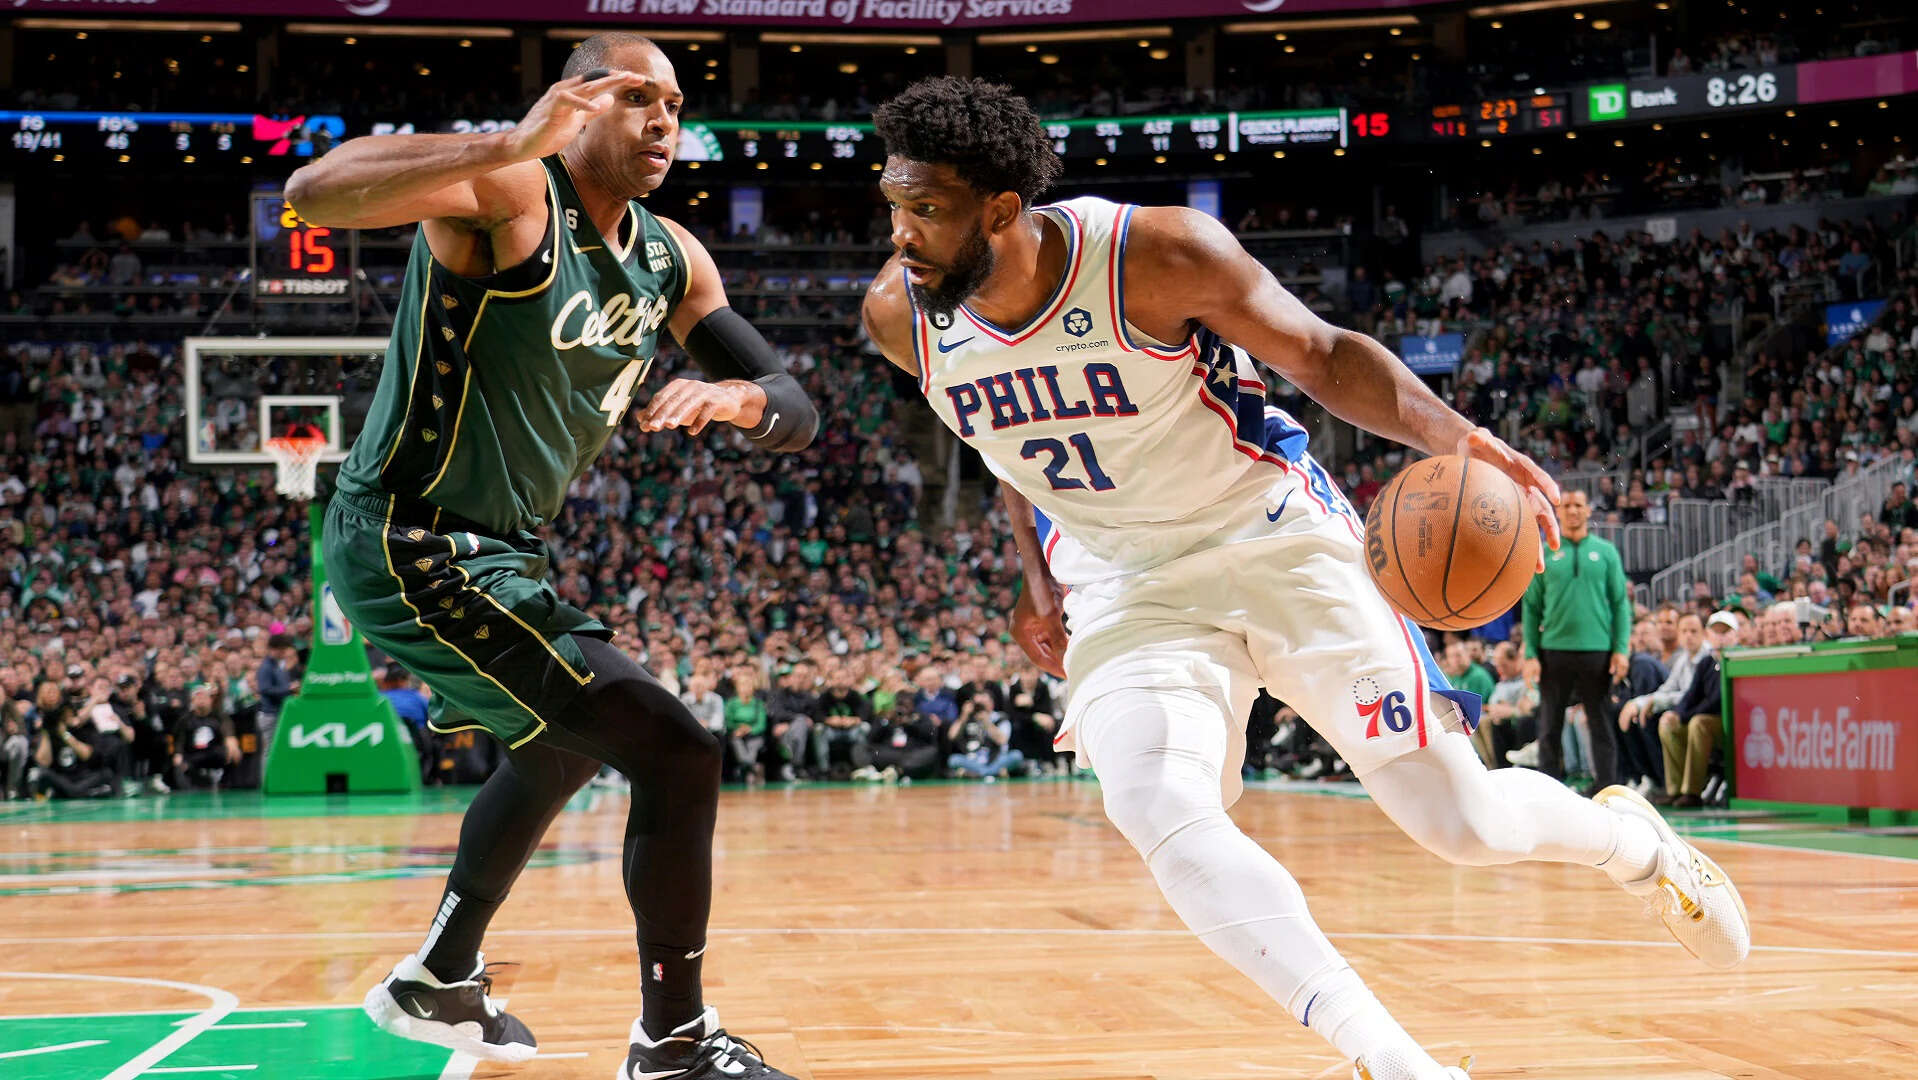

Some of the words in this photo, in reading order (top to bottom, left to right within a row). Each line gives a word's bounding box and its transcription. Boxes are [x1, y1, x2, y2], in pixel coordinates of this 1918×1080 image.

[587, 0, 635, 13] The
[640, 0, 697, 14] New
[703, 0, 826, 17] Standard
[830, 0, 858, 23] of
[862, 0, 961, 24] Facility
[965, 0, 1072, 18] Services
[1592, 91, 1624, 114] TD
[1630, 87, 1677, 108] Bank
[1706, 72, 1777, 107] 8:26
[1352, 113, 1390, 137] 15
[565, 208, 579, 231] 6
[289, 227, 335, 273] 15
[284, 279, 350, 294] TISSOT
[935, 312, 950, 327] 6
[1055, 339, 1109, 352] crypto.com
[945, 362, 1139, 438] PHILA
[1020, 432, 1117, 492] 21
[1355, 692, 1413, 740] 76
